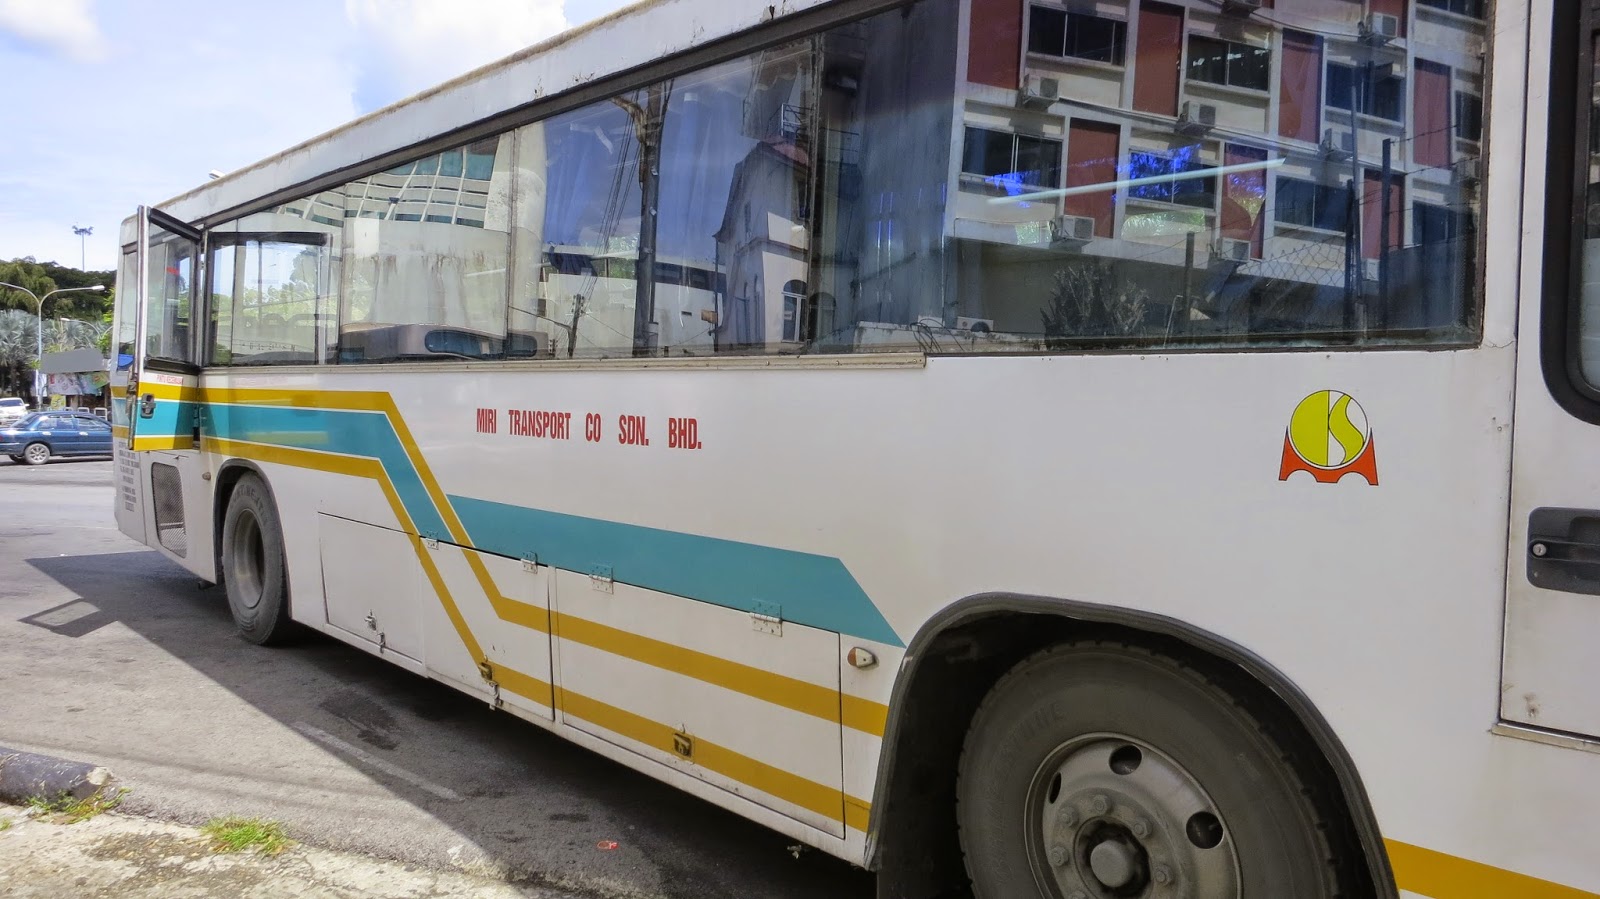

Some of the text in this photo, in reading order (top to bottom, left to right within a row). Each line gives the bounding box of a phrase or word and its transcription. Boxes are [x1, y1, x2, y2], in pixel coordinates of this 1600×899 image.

[476, 408, 702, 450] MIRI TRANSPORT CO SDN. BHD.
